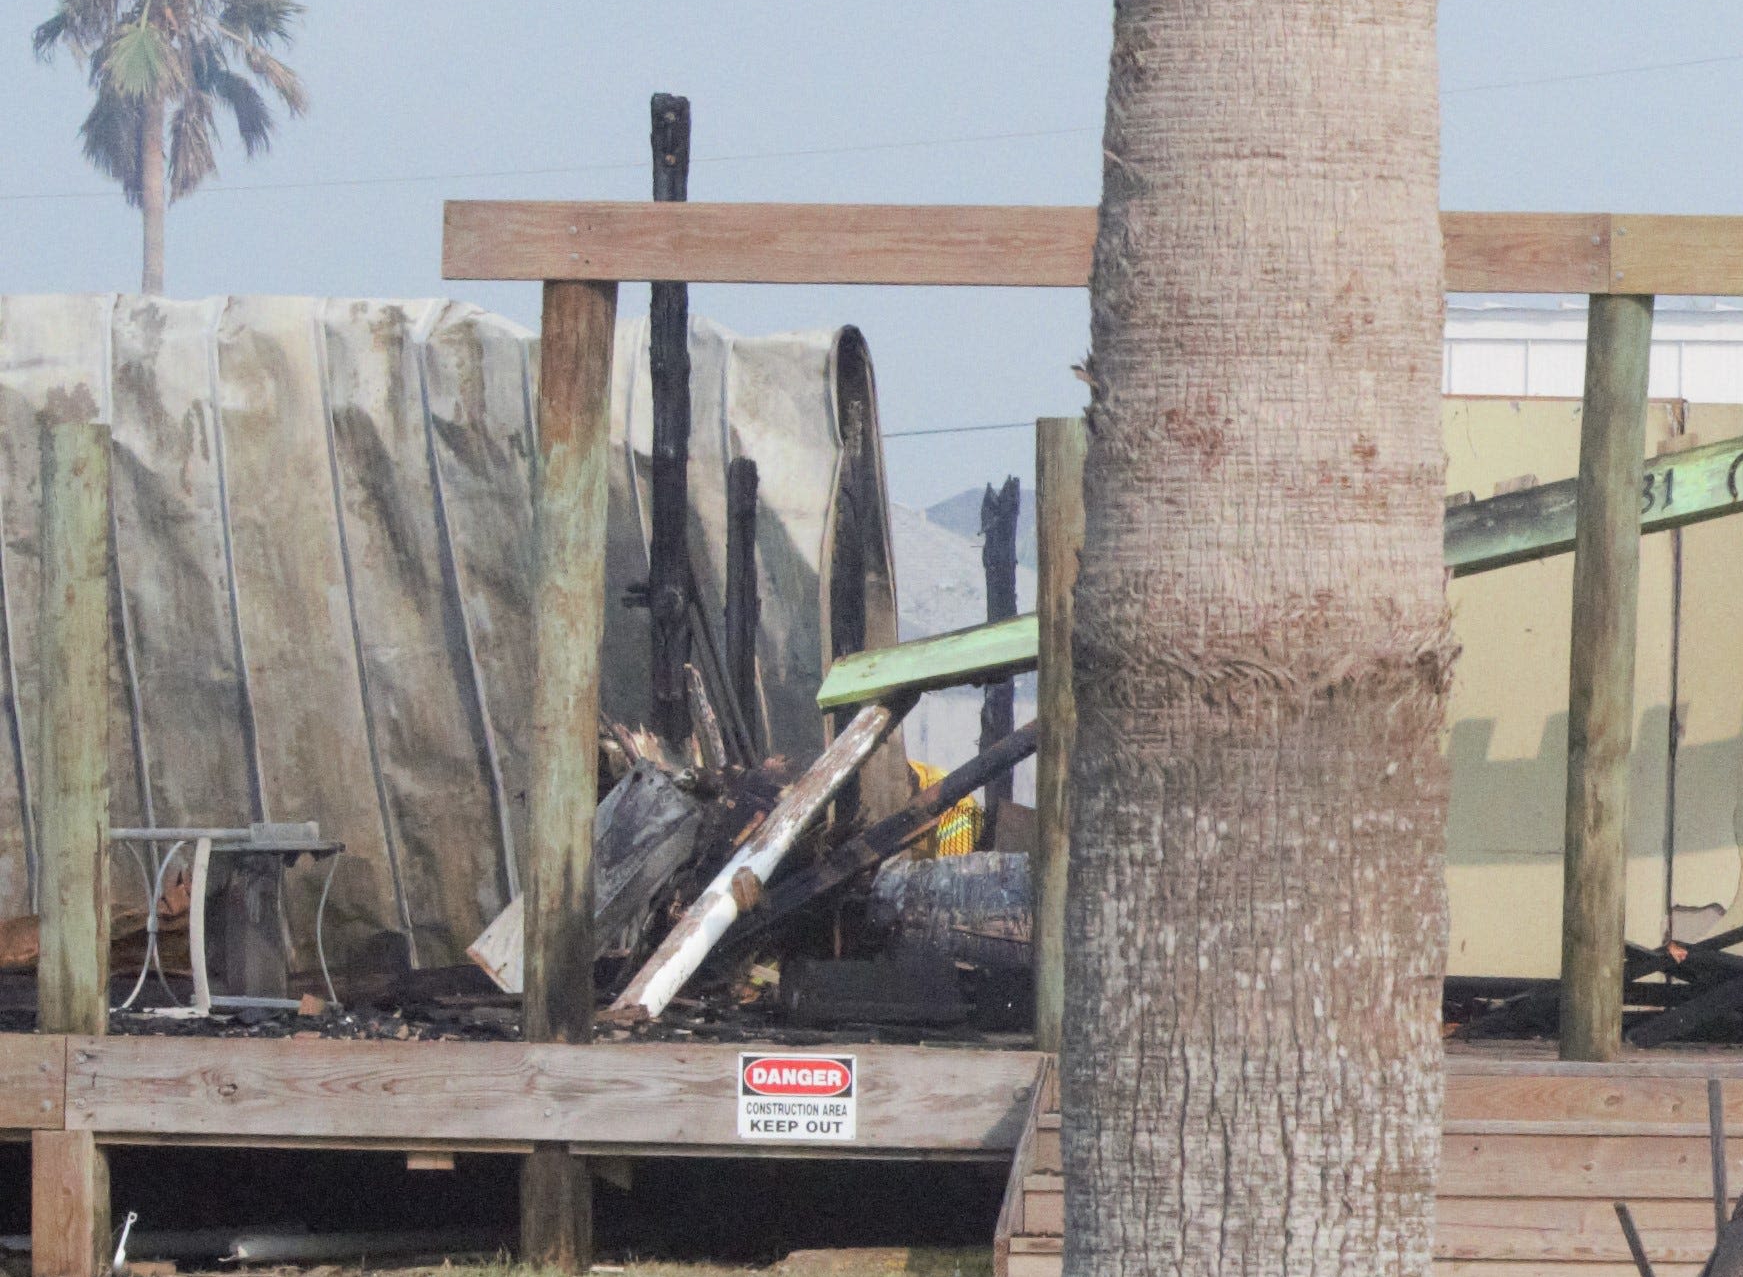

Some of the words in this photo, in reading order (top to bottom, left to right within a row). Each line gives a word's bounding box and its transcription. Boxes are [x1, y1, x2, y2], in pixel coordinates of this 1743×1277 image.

[752, 1068, 842, 1087] DANGER
[746, 1102, 819, 1116] CONSTRUCTION
[822, 1103, 848, 1117] AREA
[750, 1119, 799, 1133] KEEP
[806, 1121, 843, 1134] OUT
